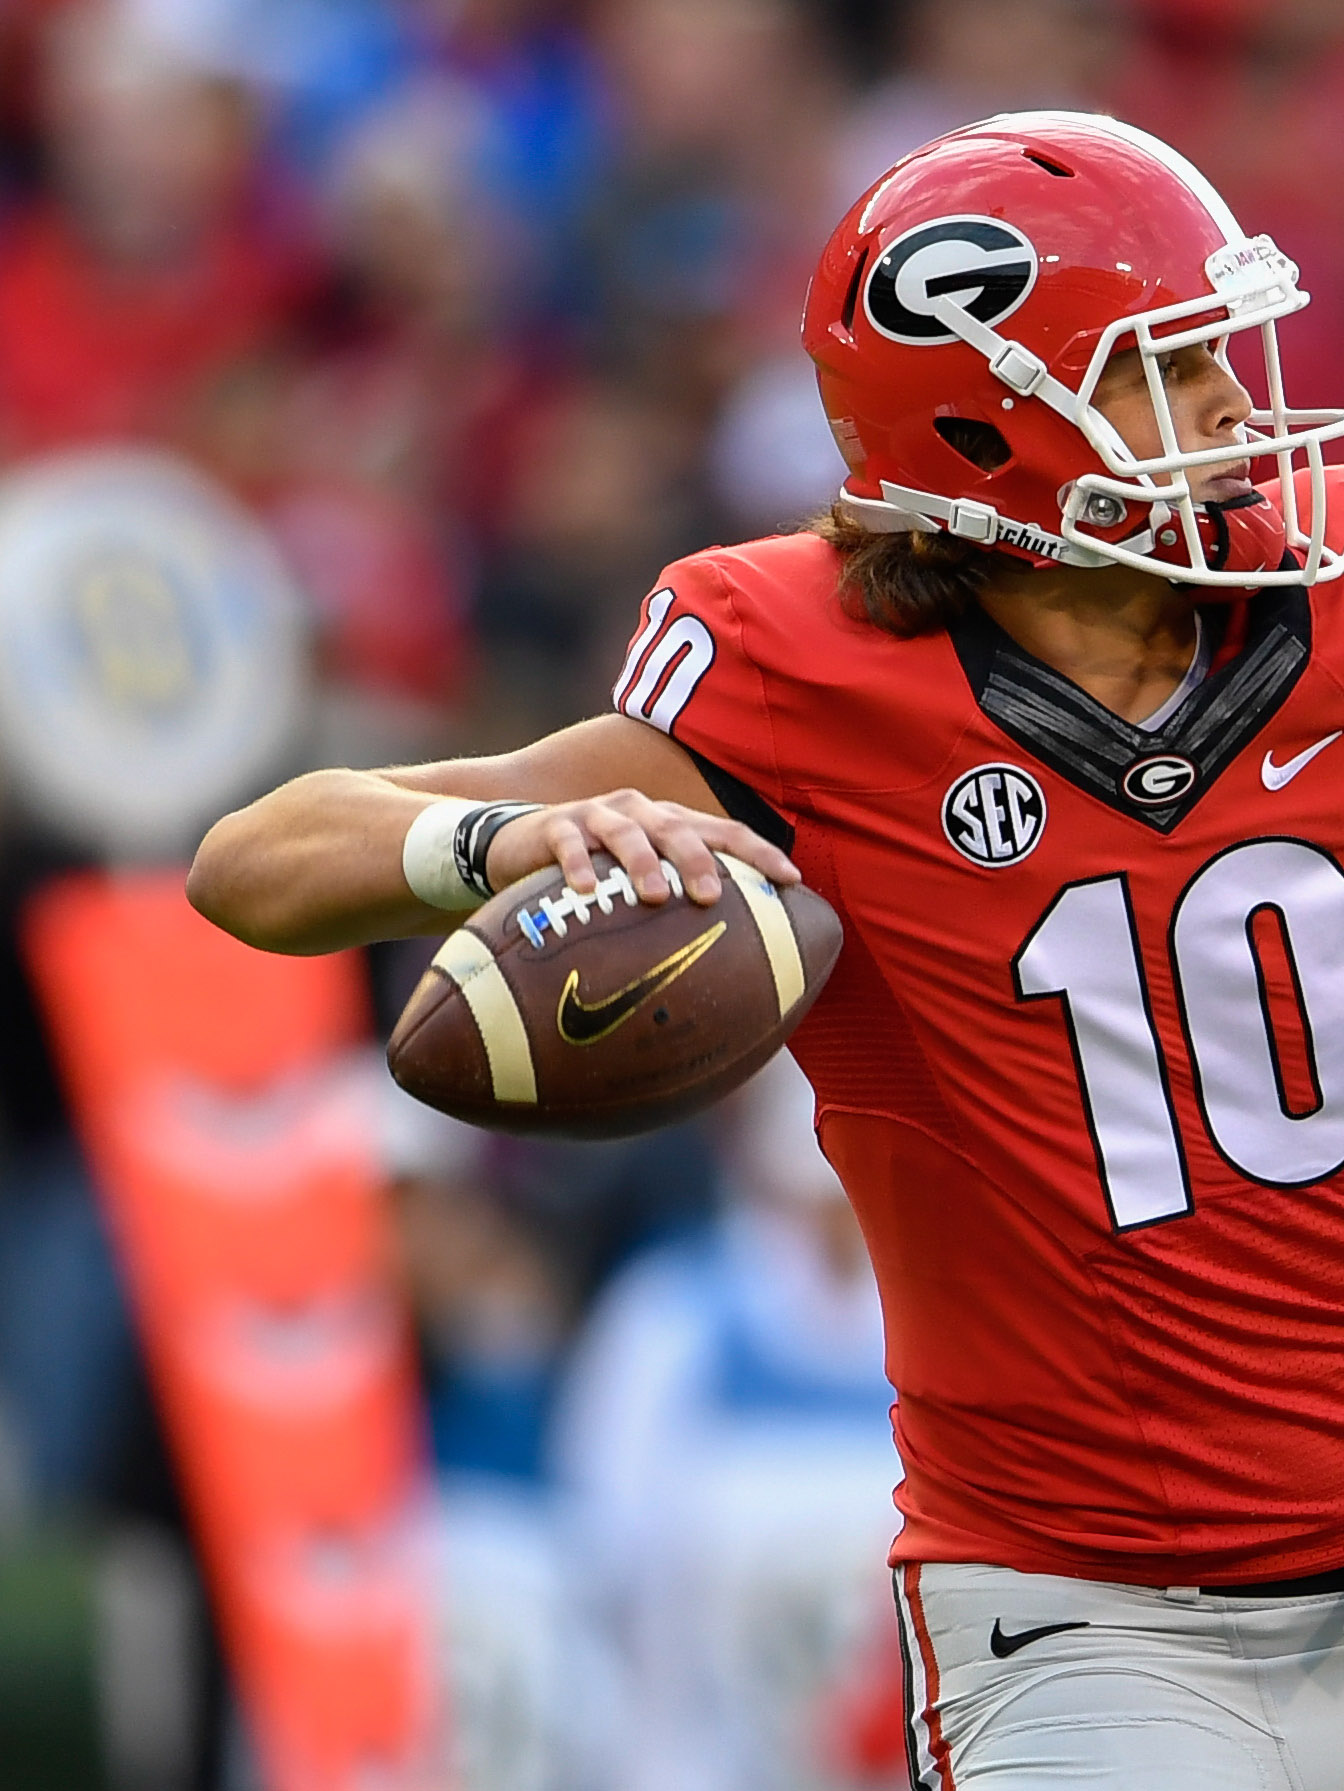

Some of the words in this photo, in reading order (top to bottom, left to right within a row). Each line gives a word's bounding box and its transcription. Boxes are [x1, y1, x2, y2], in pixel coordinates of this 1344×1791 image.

[868, 221, 1033, 338] G
[613, 587, 716, 735] 10
[951, 772, 1038, 859] SEC
[1127, 760, 1194, 799] G
